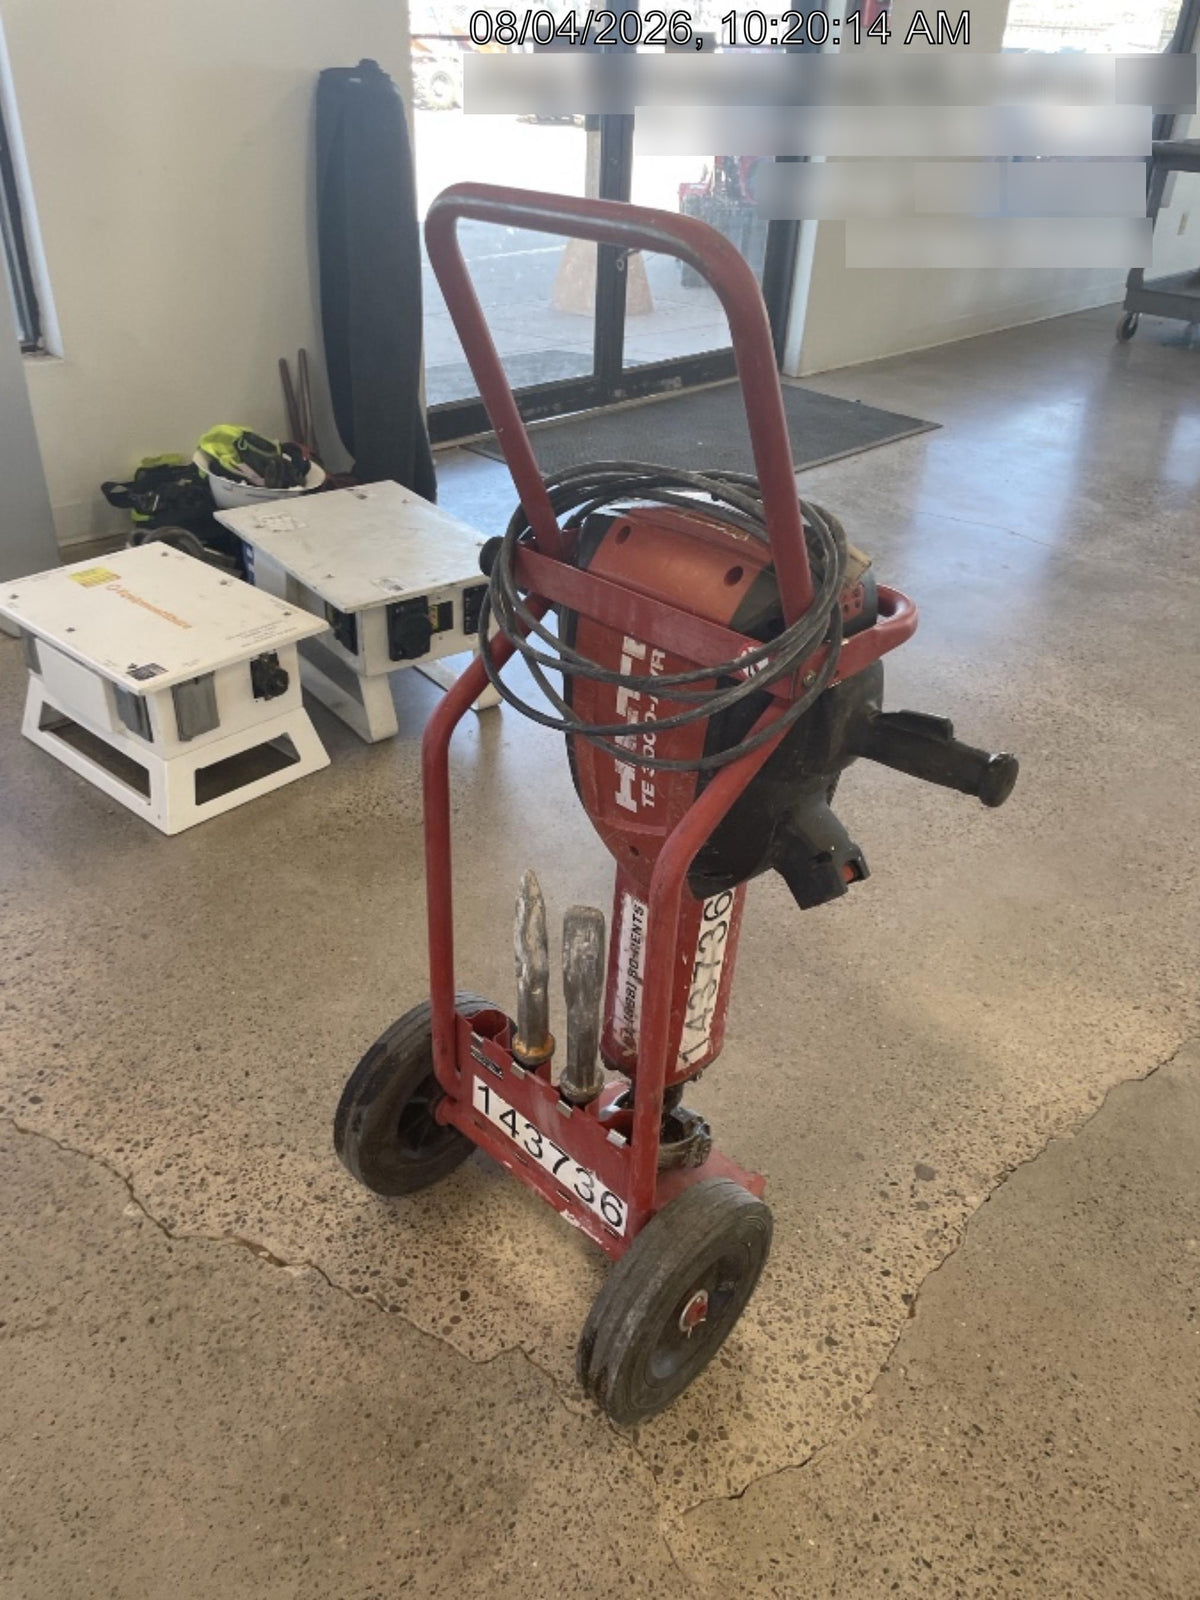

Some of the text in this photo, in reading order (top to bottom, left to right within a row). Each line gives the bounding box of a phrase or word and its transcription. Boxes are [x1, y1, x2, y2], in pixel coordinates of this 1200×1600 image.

[641, 779, 656, 808] TE
[679, 890, 733, 1063] 143736
[477, 1084, 624, 1228] 143736
